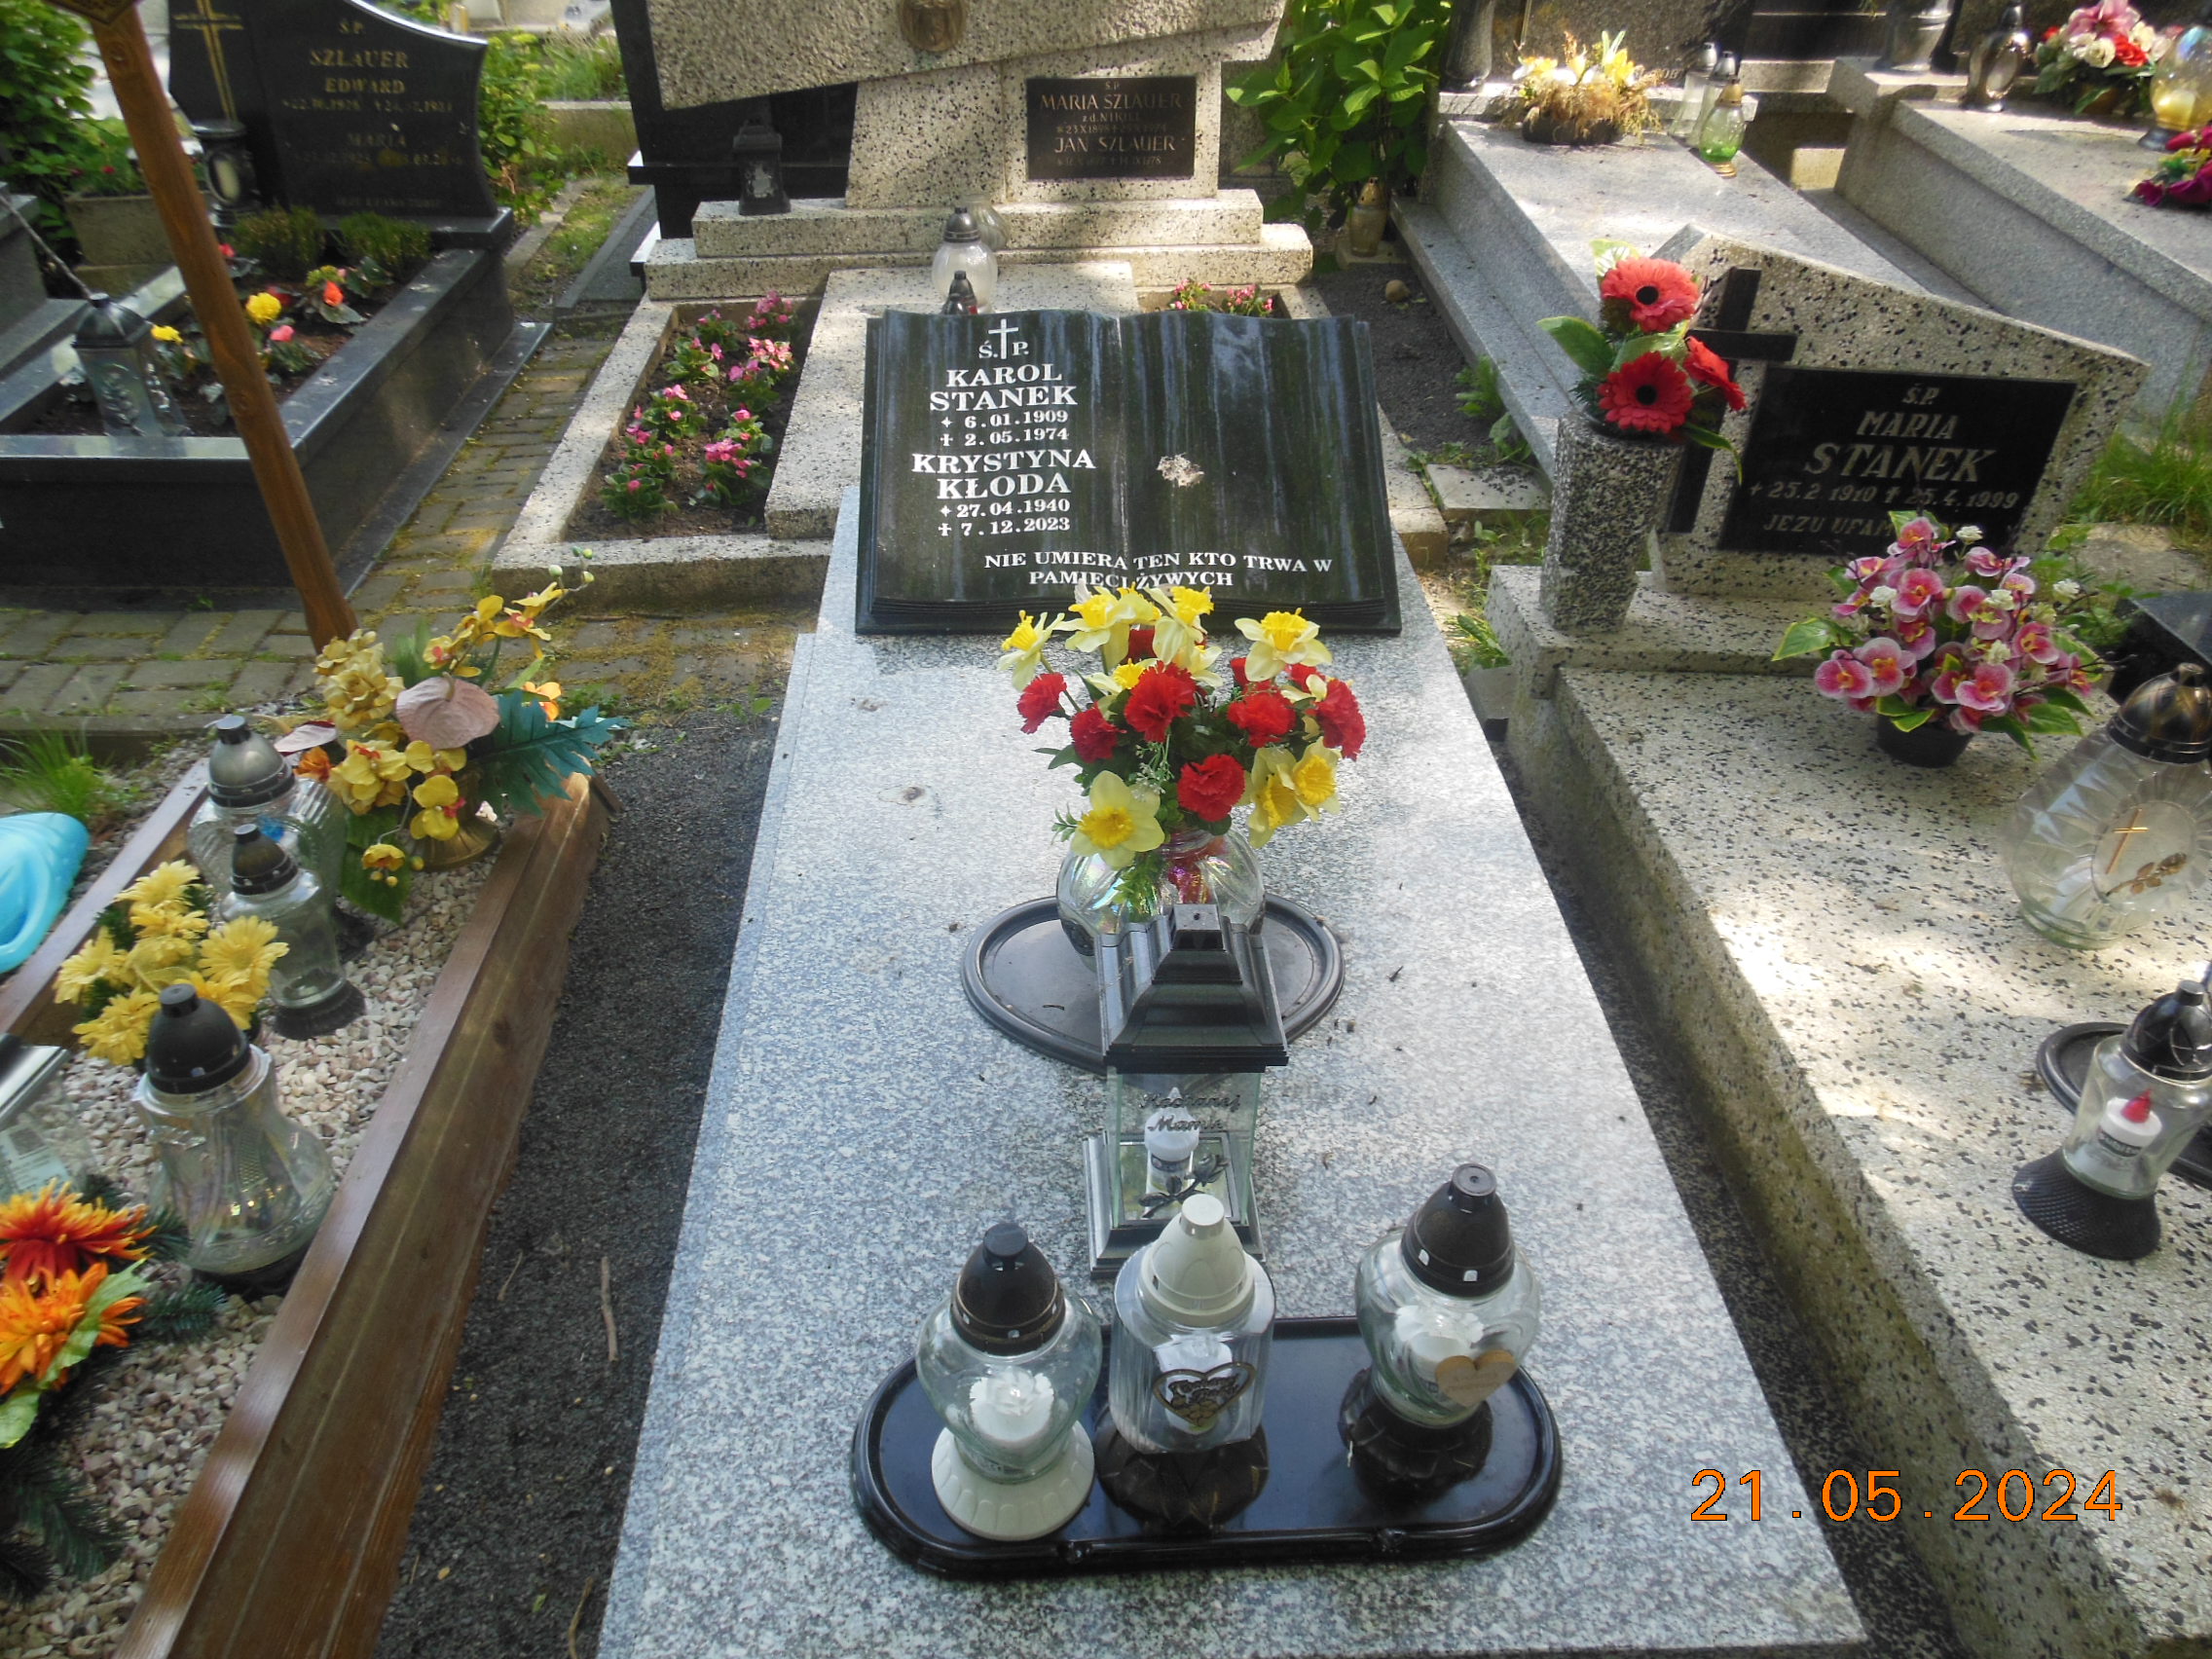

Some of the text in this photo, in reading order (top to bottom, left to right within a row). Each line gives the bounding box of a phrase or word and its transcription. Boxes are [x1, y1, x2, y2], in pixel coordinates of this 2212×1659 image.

[310, 49, 409, 68] SZLAUER
[325, 78, 405, 93] EDWARD
[1040, 92, 1183, 110] MARIA SZLAUER
[1054, 135, 1175, 153] JAN SZLAUER
[946, 363, 1062, 387] KAROL
[930, 386, 1078, 412] STANEK
[1857, 410, 1960, 439] MARIA
[911, 449, 1097, 474] KRYSTYNA
[1804, 442, 1998, 483] STANEK
[937, 472, 1072, 499] KŁODA
[956, 498, 1071, 518] 27.04.1940
[1763, 514, 1825, 533] JEZU
[984, 551, 1333, 573] NIE UMIERA TEN KTO TRWA W
[1135, 571, 1235, 591] ŻYWYCH
